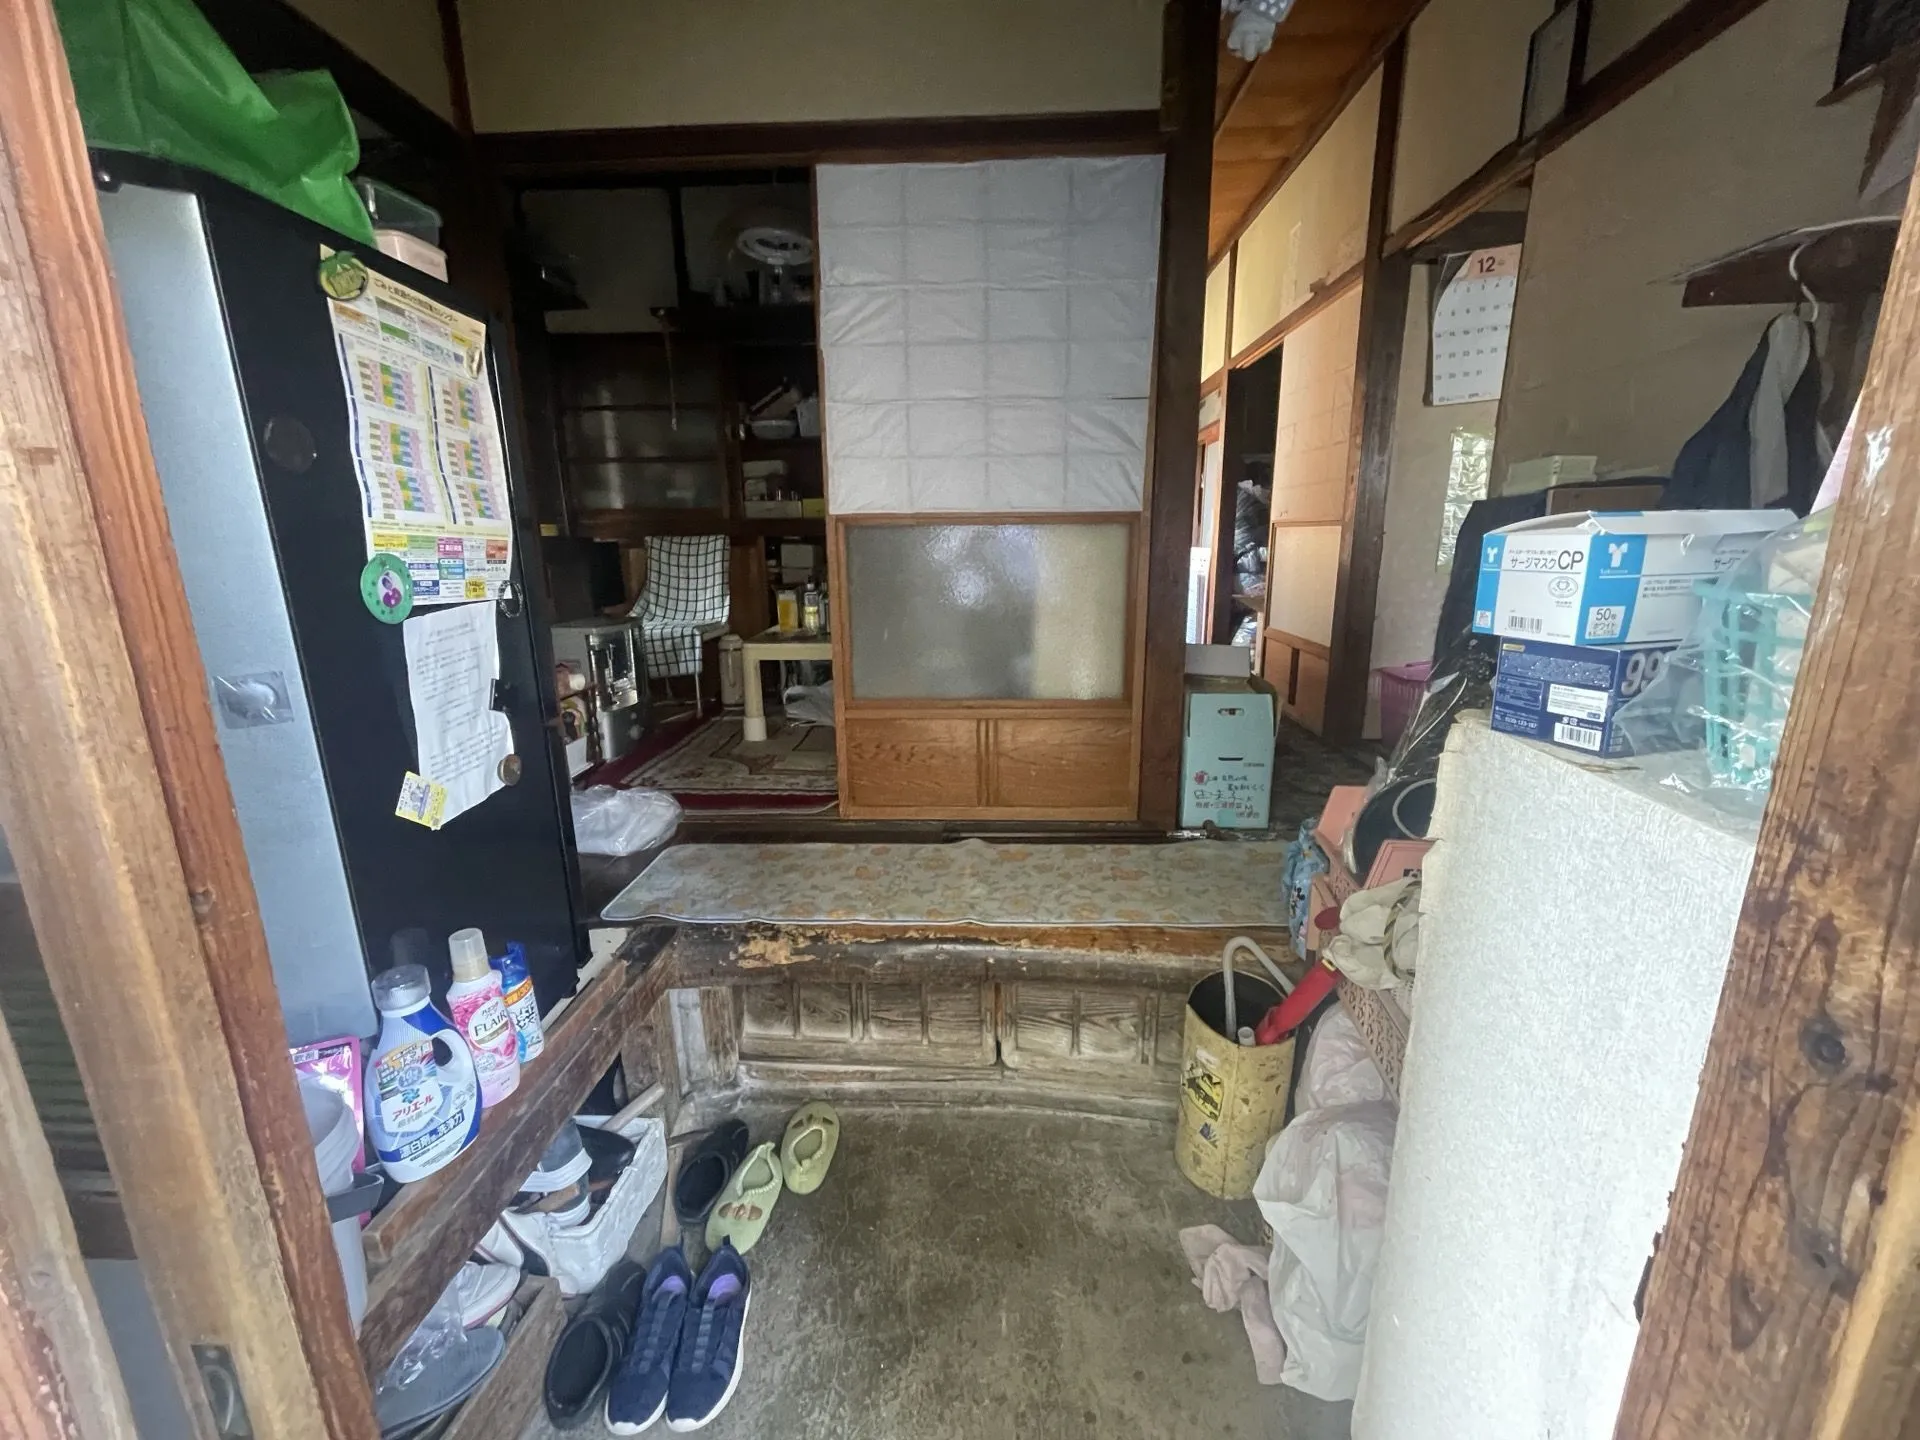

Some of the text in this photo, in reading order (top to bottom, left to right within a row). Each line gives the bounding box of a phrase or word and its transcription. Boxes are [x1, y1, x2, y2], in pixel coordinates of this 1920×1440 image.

[1477, 256, 1497, 274] 12
[474, 1009, 508, 1037] FLAIR
[392, 1094, 434, 1122] アリエール
